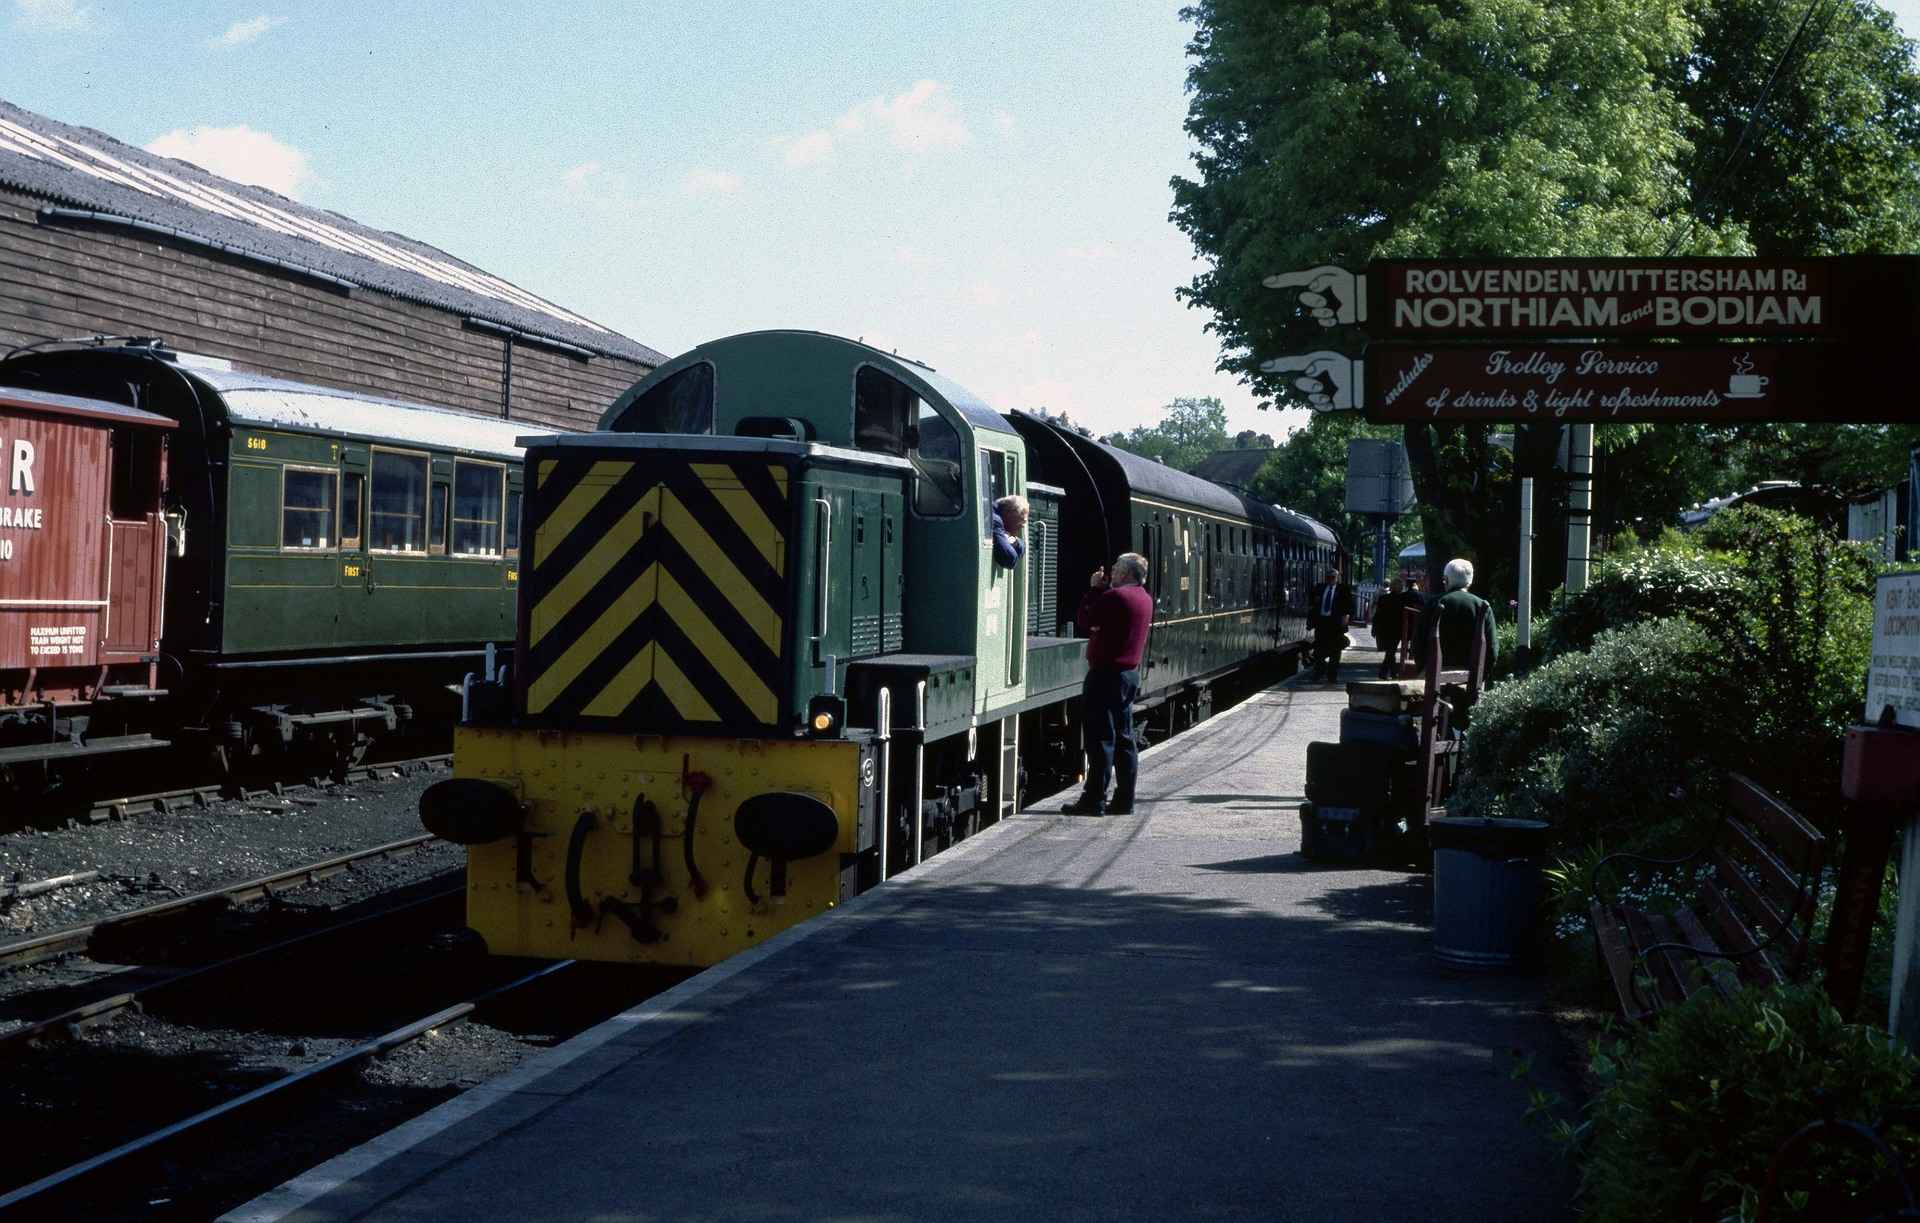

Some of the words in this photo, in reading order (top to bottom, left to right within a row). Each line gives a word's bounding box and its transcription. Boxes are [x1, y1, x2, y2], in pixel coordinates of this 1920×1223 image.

[1395, 297, 1617, 328] NORTHIAM
[1619, 299, 1656, 326] and
[1655, 296, 1821, 326] BODIAM
[1485, 350, 1566, 385] Trolley
[1575, 350, 1658, 375] Service
[1385, 353, 1434, 405] includes
[1425, 388, 1450, 416] of
[1453, 389, 1518, 409] drinks
[1522, 389, 1540, 413] &
[1544, 388, 1594, 417] light
[1600, 386, 1721, 416] refreshments
[247, 437, 267, 450] 5618
[344, 565, 360, 577] FIRST
[30, 627, 59, 636] MAXIMUM
[31, 636, 49, 645] TRAIN
[50, 636, 72, 645] WEIGHT
[72, 636, 85, 645] NOT
[30, 646, 39, 655] TO
[39, 646, 61, 655] EXCEED
[69, 645, 84, 654] TONS
[1837, 865, 1872, 973] TRAIN
